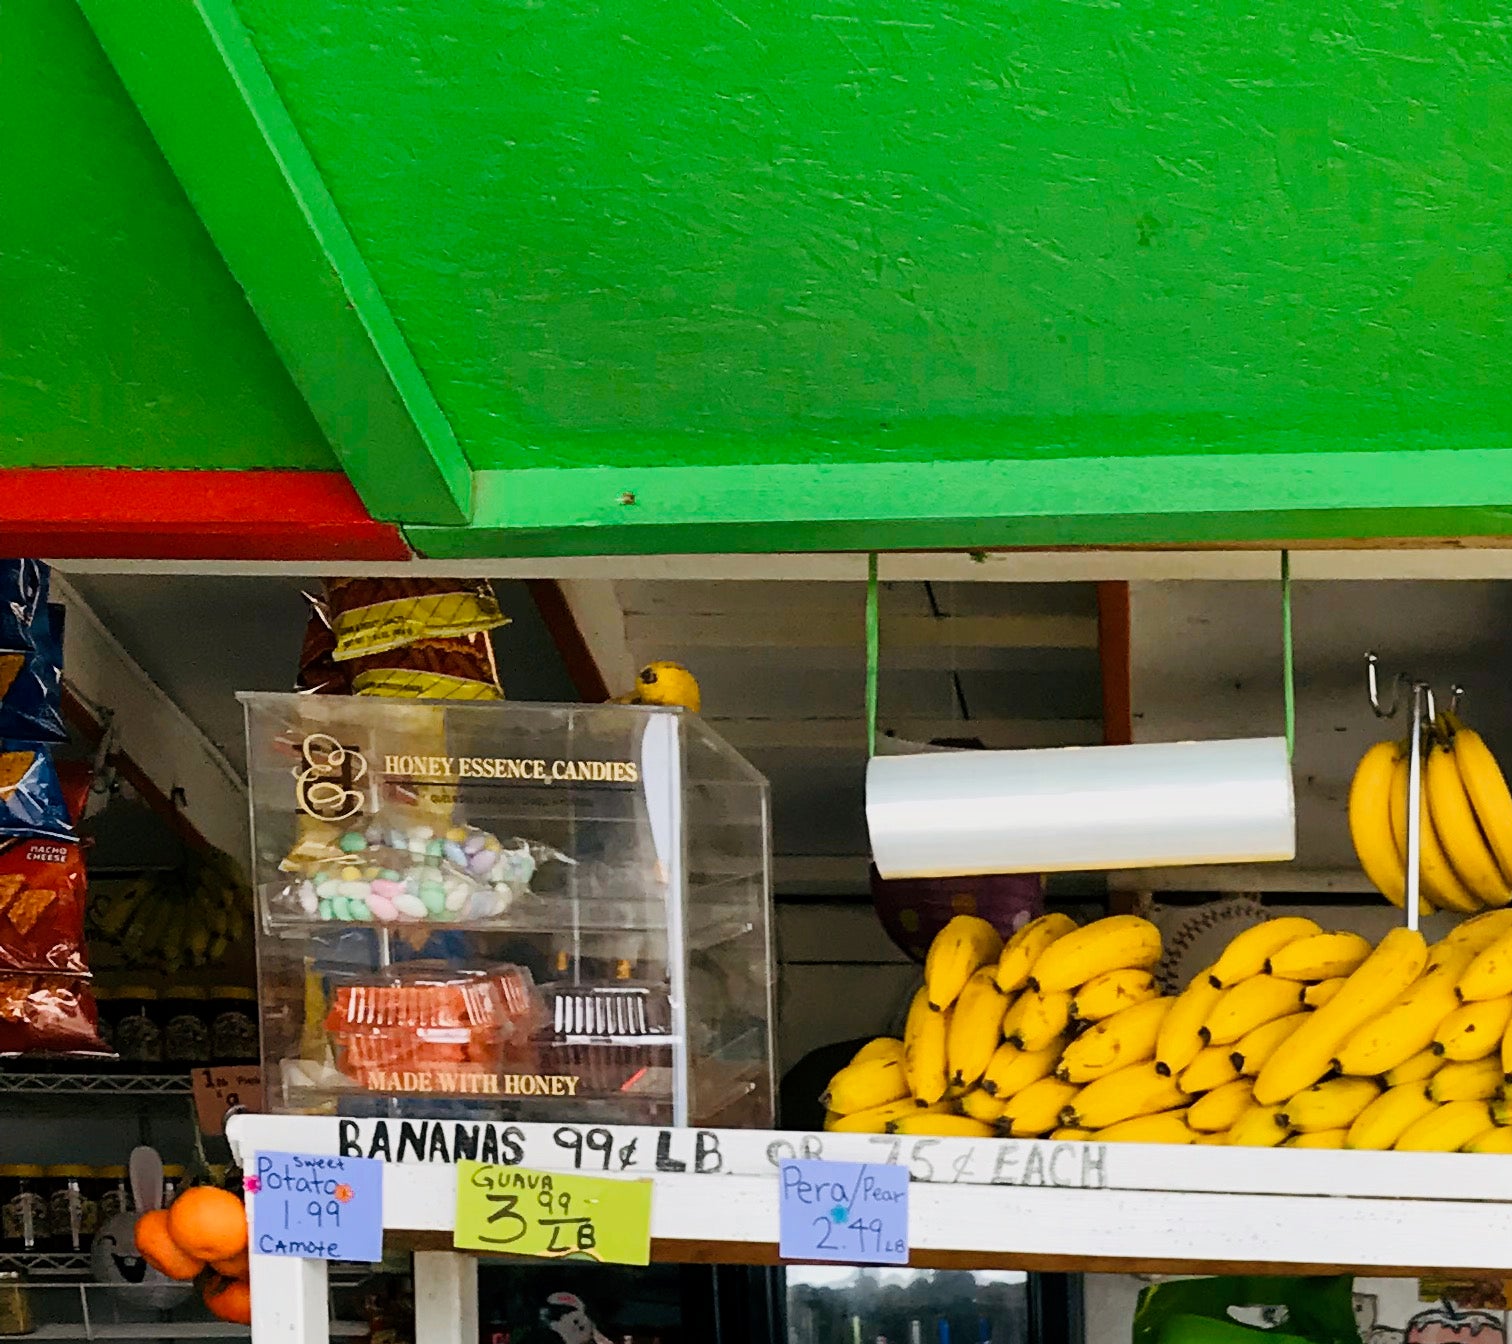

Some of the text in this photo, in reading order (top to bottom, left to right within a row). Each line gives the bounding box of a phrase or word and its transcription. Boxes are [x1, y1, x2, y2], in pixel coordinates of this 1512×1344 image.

[384, 755, 638, 783] HONEY ESSENCE CANDIES
[26, 852, 67, 863] CHEESE
[368, 1071, 579, 1096] MADE WITH HONEY
[338, 1119, 525, 1166] BANANAS
[471, 1166, 553, 1190] GUAVA
[992, 1144, 1108, 1187] EACH
[478, 1192, 571, 1243] 3 99
[547, 1223, 596, 1251] LB
